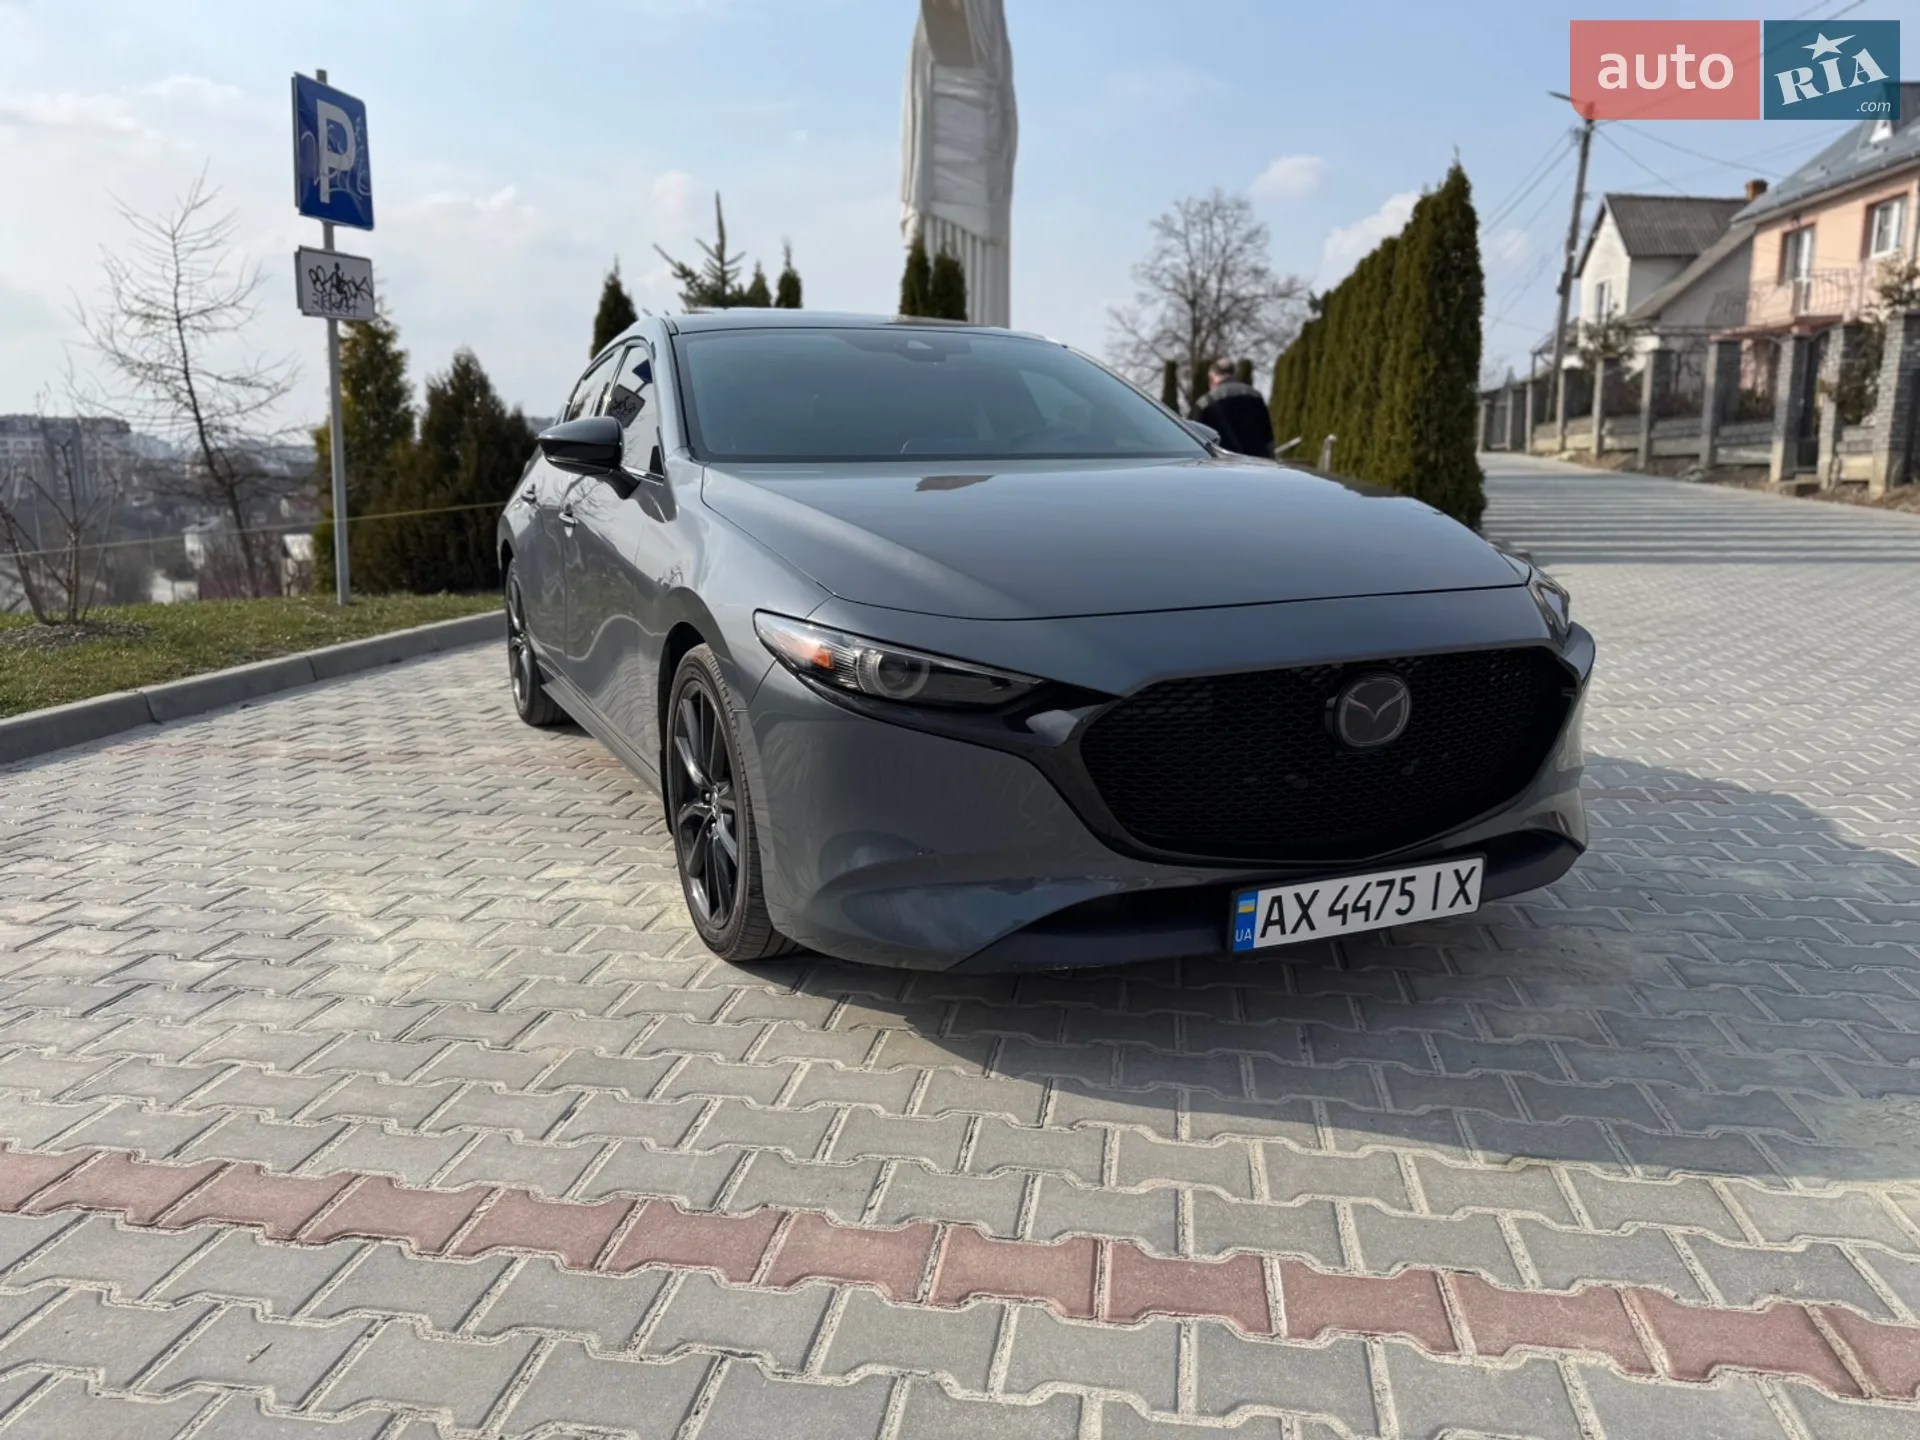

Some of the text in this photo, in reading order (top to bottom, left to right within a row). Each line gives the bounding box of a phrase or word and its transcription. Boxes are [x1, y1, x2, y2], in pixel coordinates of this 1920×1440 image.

[316, 98, 356, 204] P
[1235, 927, 1252, 942] UA
[1260, 866, 1477, 938] AX 4475 IX
